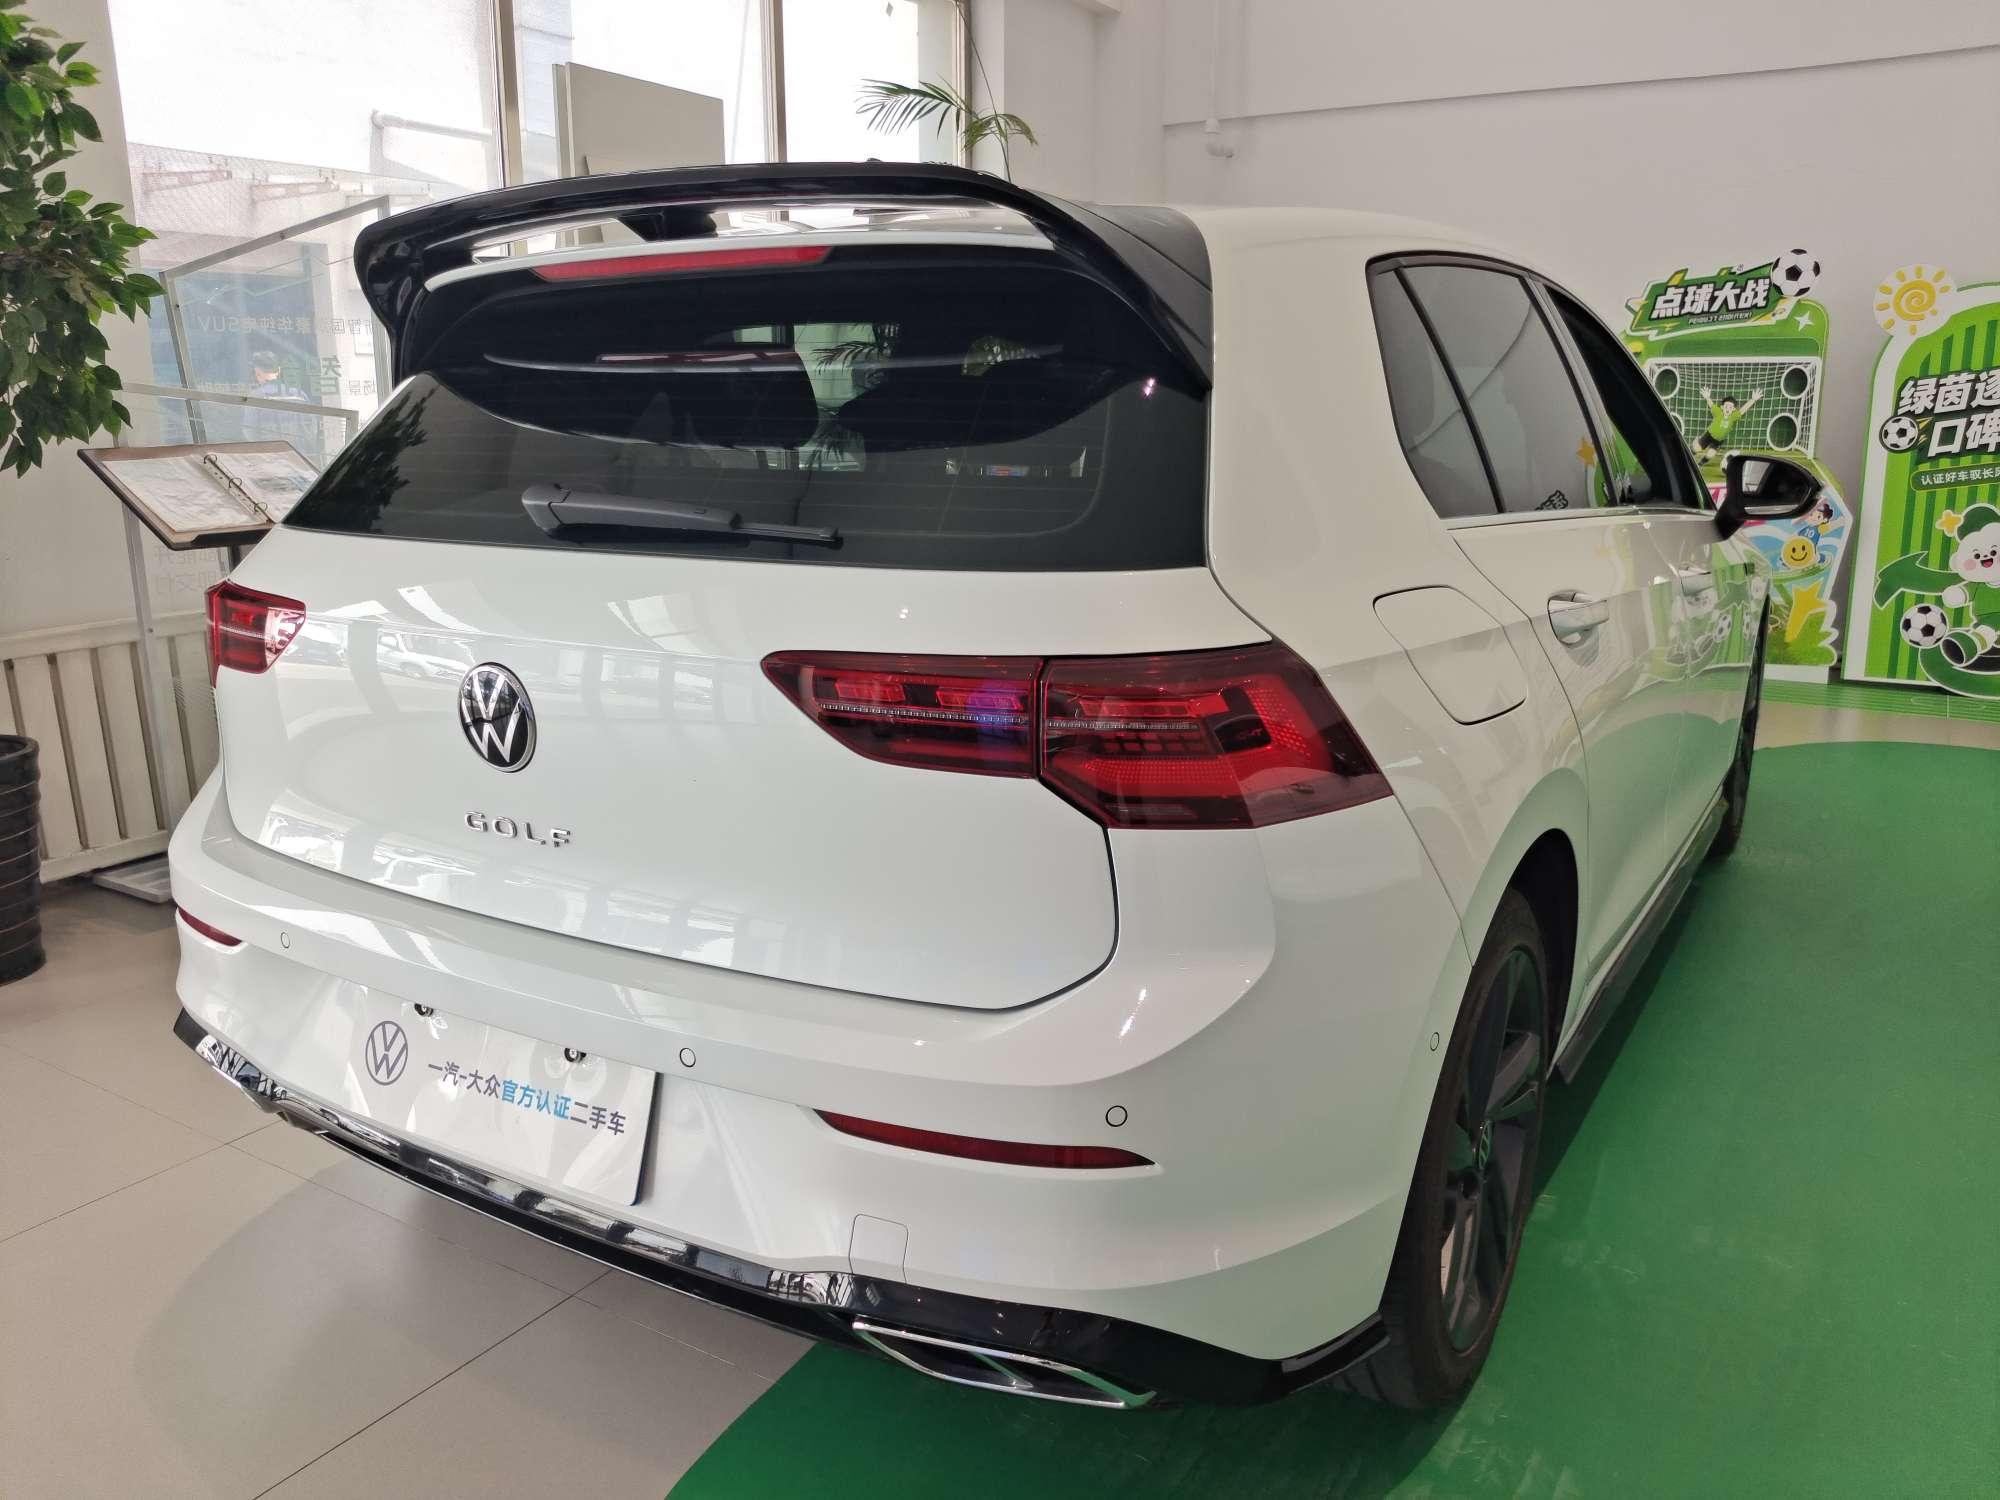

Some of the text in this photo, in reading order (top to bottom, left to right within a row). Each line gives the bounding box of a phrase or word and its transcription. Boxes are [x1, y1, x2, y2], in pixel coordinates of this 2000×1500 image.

[1651, 278, 1770, 318] 点球大战
[1928, 408, 2000, 457] 口碑
[464, 811, 572, 848] GOLF
[428, 1060, 626, 1135] 一汽-大众官方认证二手车
